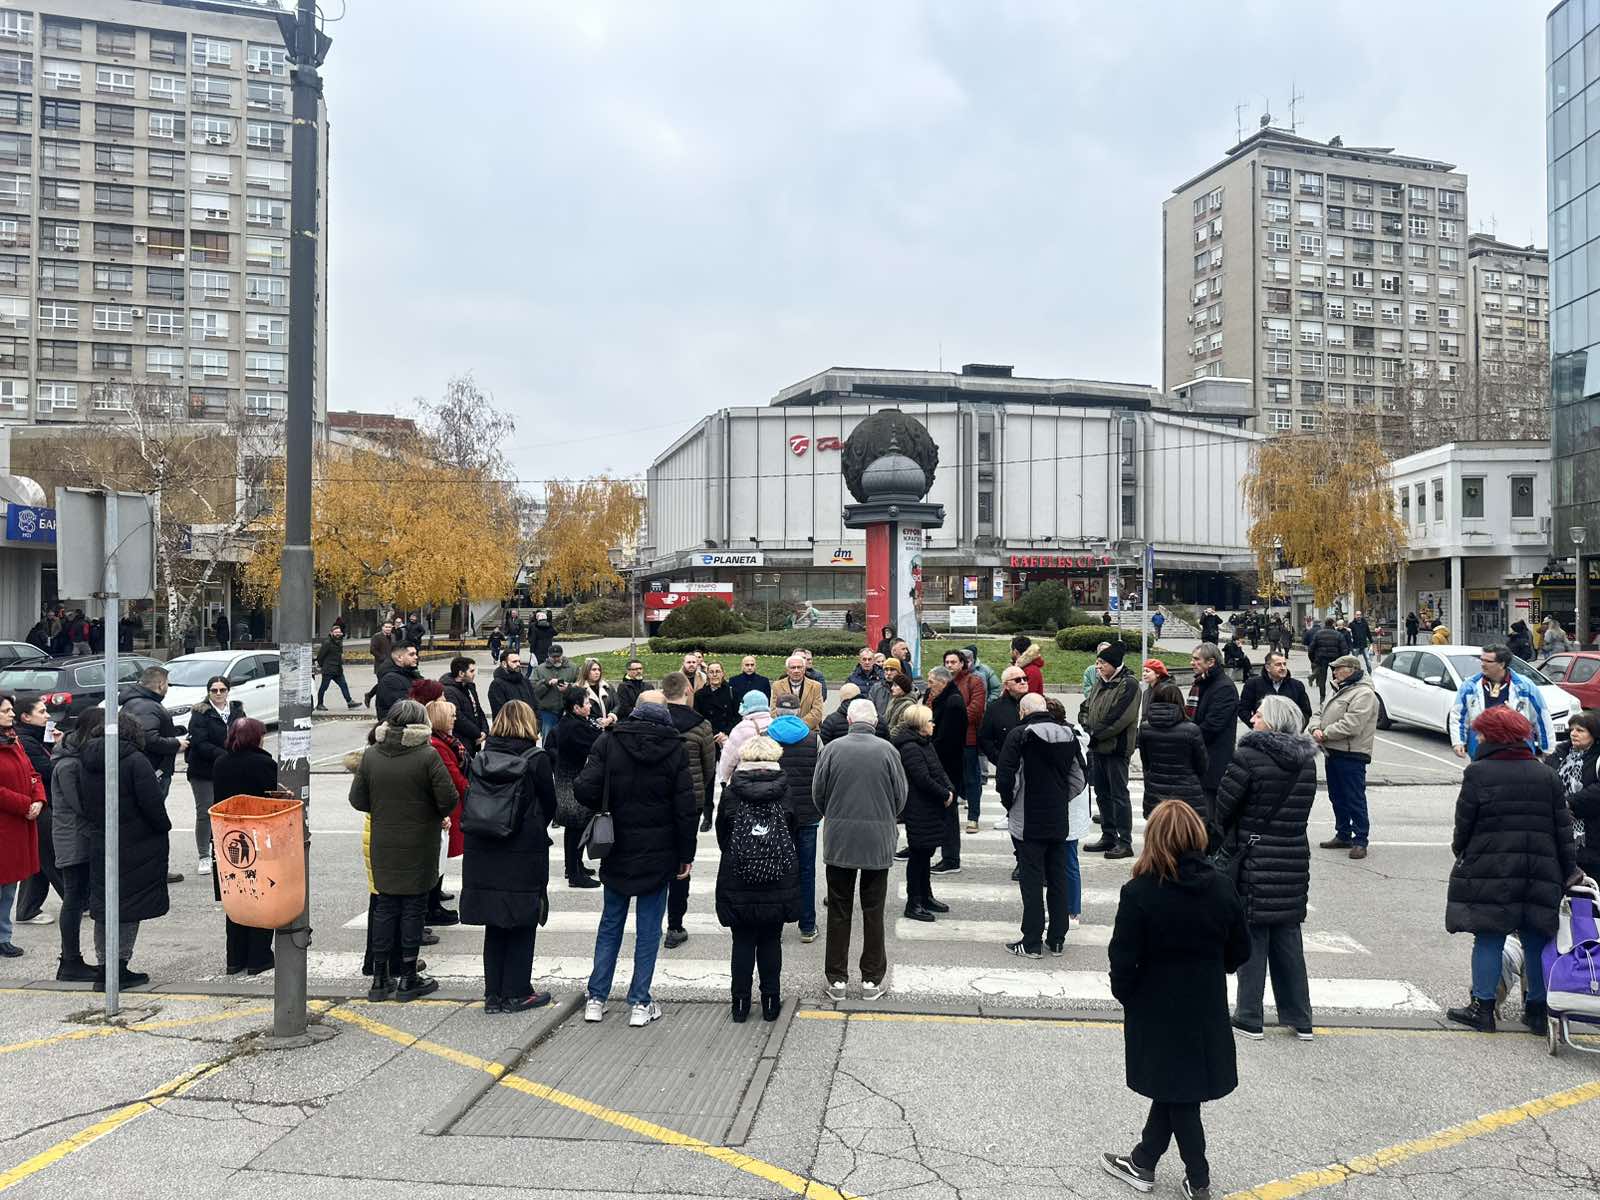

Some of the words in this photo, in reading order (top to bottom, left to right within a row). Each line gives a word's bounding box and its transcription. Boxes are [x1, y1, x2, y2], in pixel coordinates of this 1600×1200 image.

[833, 547, 852, 558] dm
[702, 554, 757, 565] ePLANETA
[1010, 555, 1073, 568] RAFFLES
[1076, 555, 1112, 568] CIY
